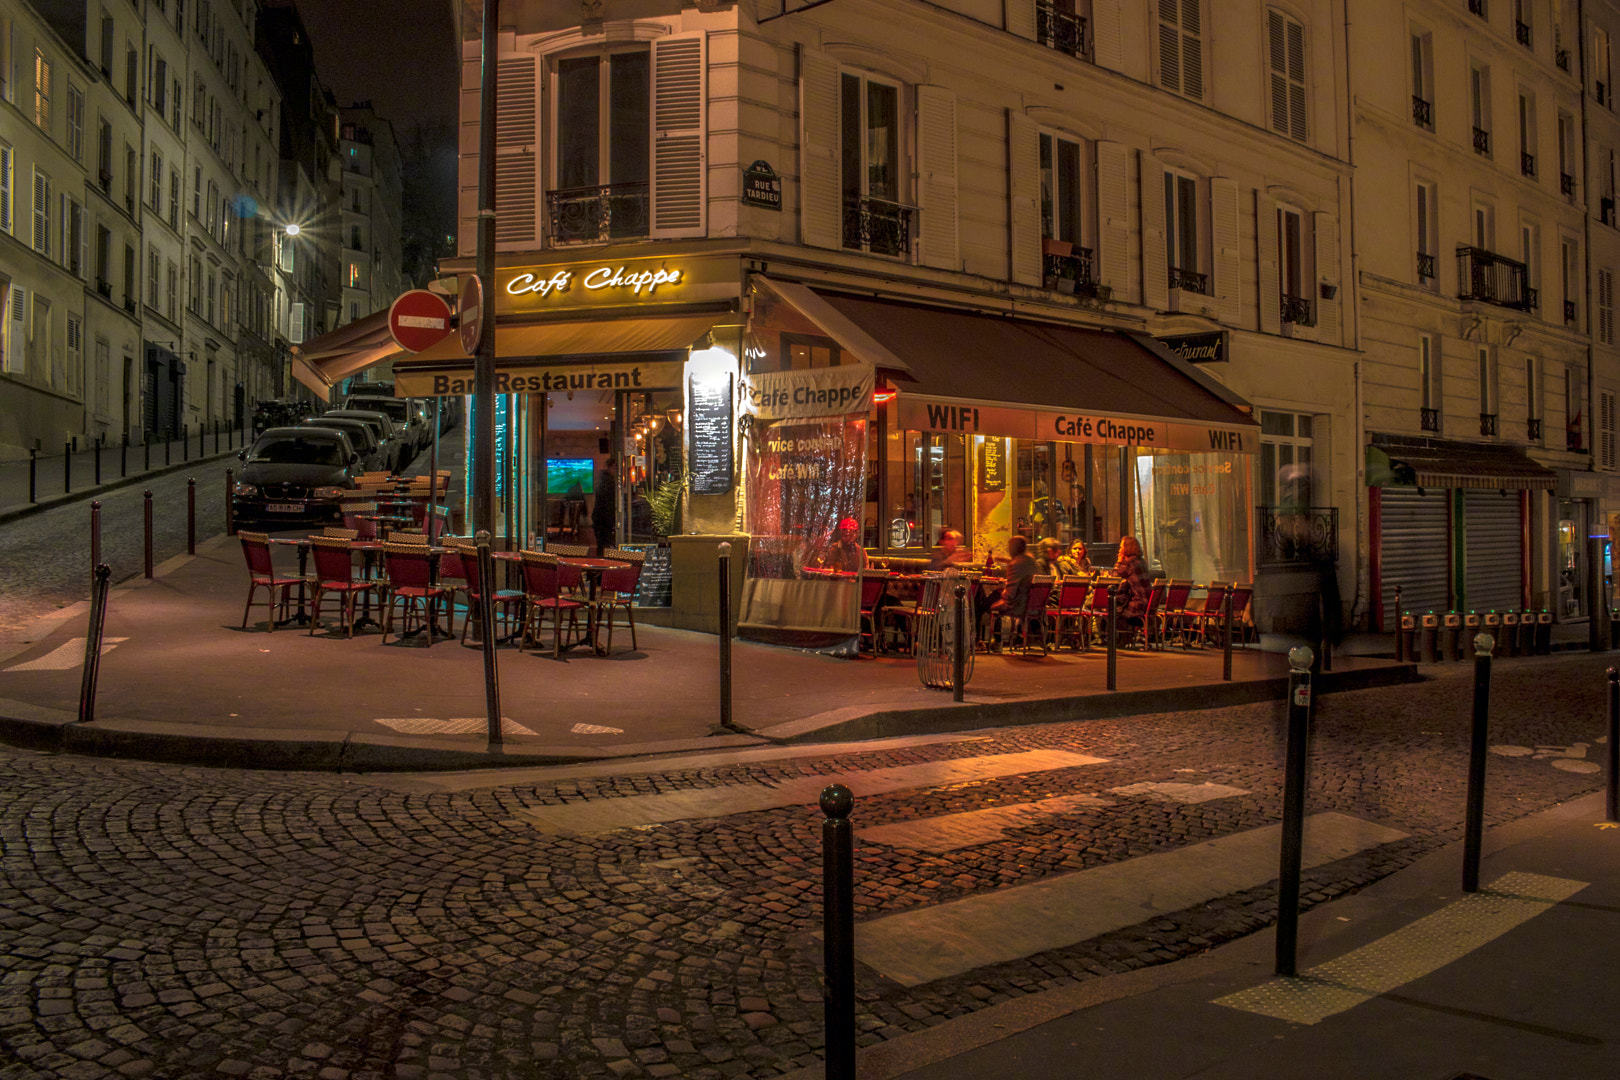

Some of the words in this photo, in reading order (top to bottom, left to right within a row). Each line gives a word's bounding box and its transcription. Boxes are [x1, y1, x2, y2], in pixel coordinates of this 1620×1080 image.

[746, 188, 778, 201] TARDIEU
[755, 179, 770, 191] RUE
[507, 270, 572, 297] Café
[584, 266, 681, 294] Chappe
[433, 375, 475, 395] Bar
[494, 367, 643, 393] Restaurant
[751, 388, 788, 407] Café
[793, 385, 861, 408] Chappe
[926, 404, 979, 432] WIFI
[1055, 416, 1092, 438] Café
[1096, 416, 1155, 446] Chappe
[1208, 429, 1243, 451] WIFI
